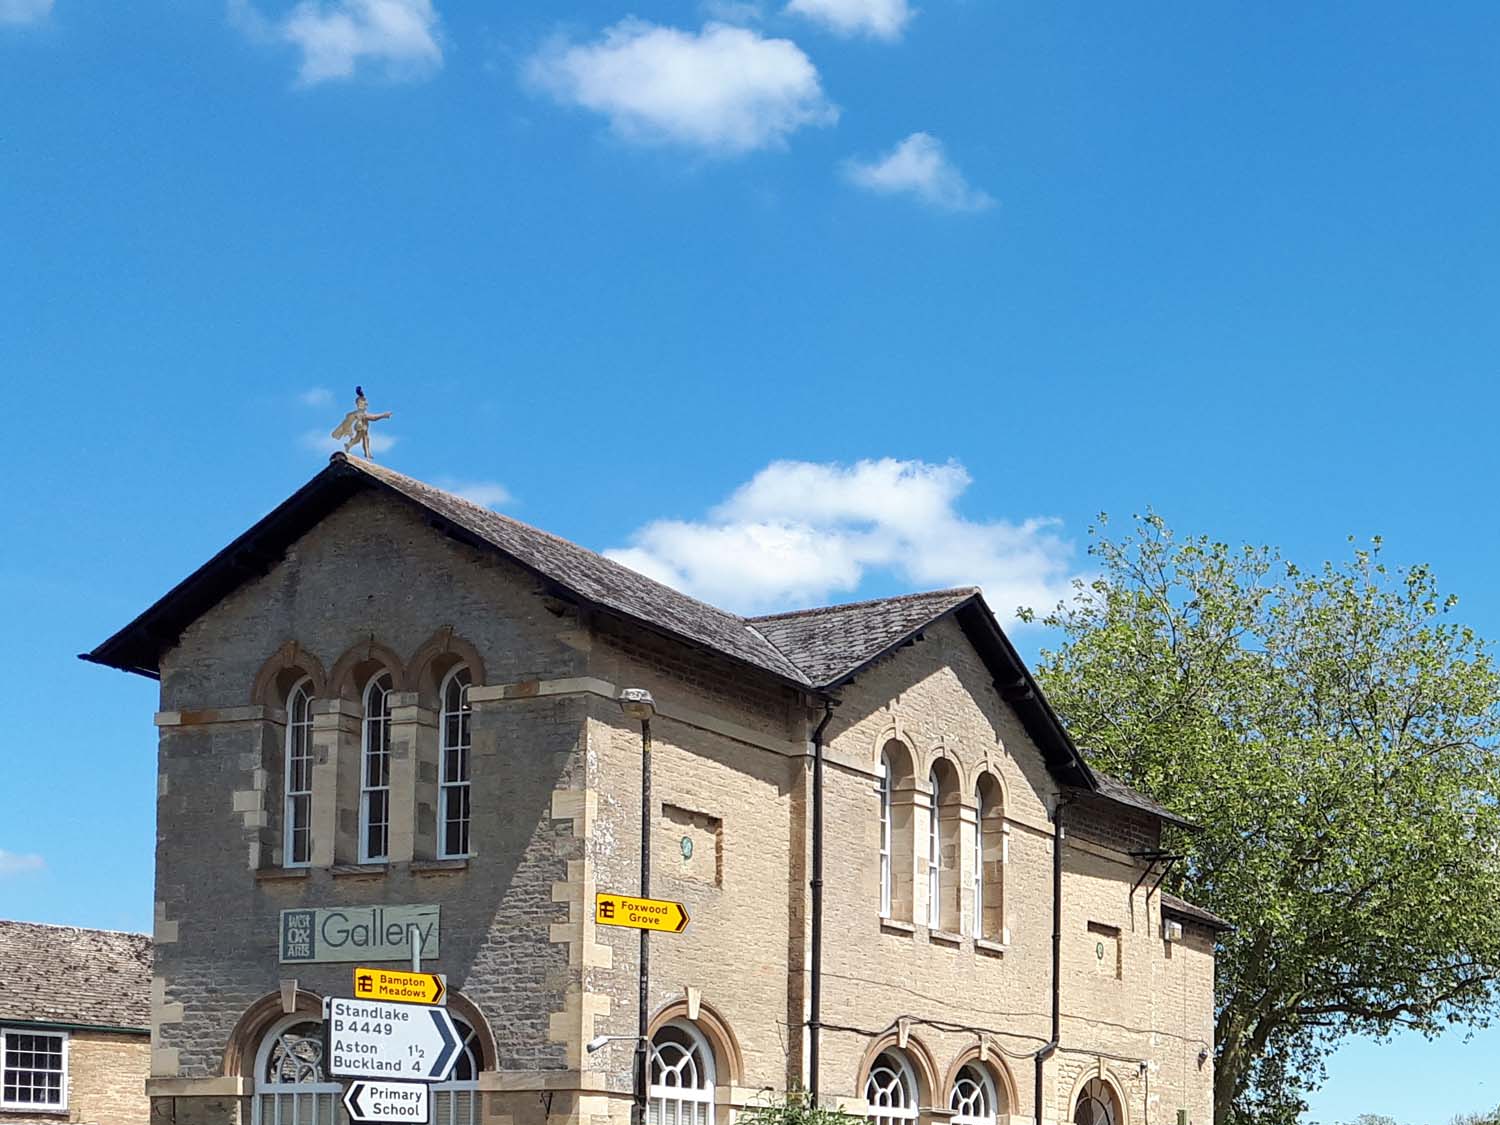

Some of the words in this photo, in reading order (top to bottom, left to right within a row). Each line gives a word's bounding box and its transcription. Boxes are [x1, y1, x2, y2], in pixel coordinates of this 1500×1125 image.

[621, 900, 668, 914] Foxwood
[629, 913, 660, 924] Grove
[322, 908, 433, 956] Gallery
[380, 975, 425, 987] Bampton
[379, 986, 426, 998] Meadows
[335, 1003, 409, 1021] Standlake
[348, 1021, 393, 1036] 4449
[334, 1040, 378, 1054] Aston
[334, 1056, 402, 1072] Buckland
[411, 1061, 421, 1073] 4
[370, 1087, 422, 1103] Primary
[373, 1102, 420, 1116] School
